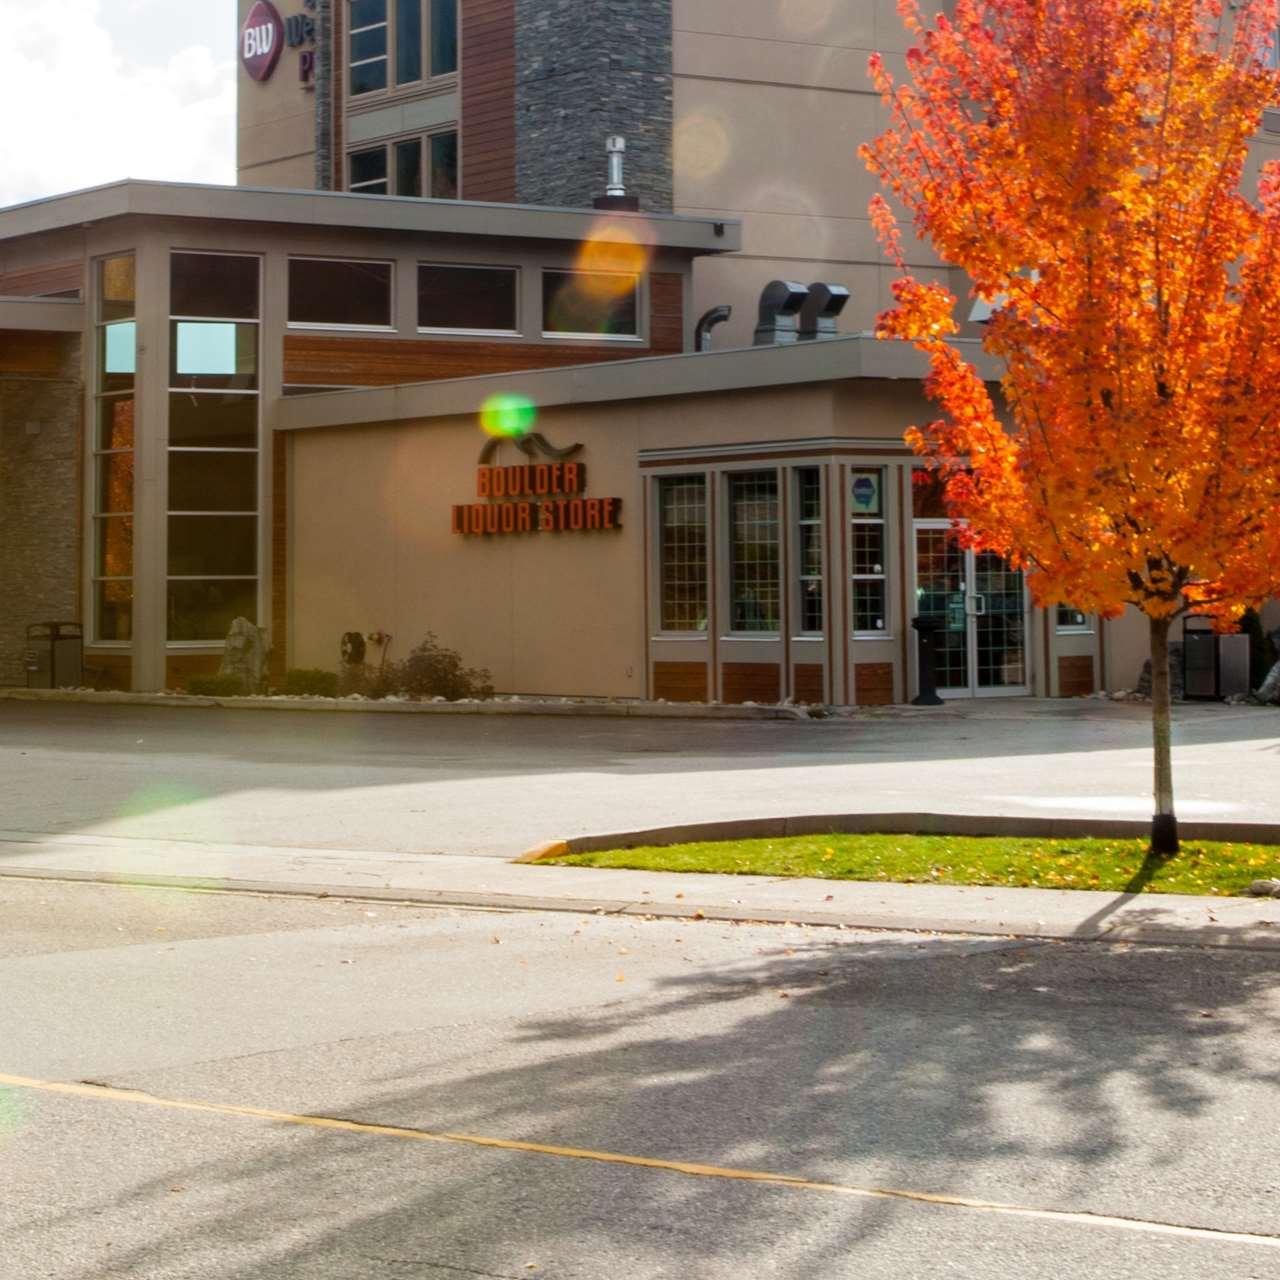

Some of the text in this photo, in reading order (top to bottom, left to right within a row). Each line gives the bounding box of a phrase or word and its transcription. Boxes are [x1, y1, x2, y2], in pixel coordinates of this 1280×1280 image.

[243, 22, 273, 59] BW
[477, 463, 580, 497] BOULDER
[452, 497, 618, 534] LIQUOR STORE
